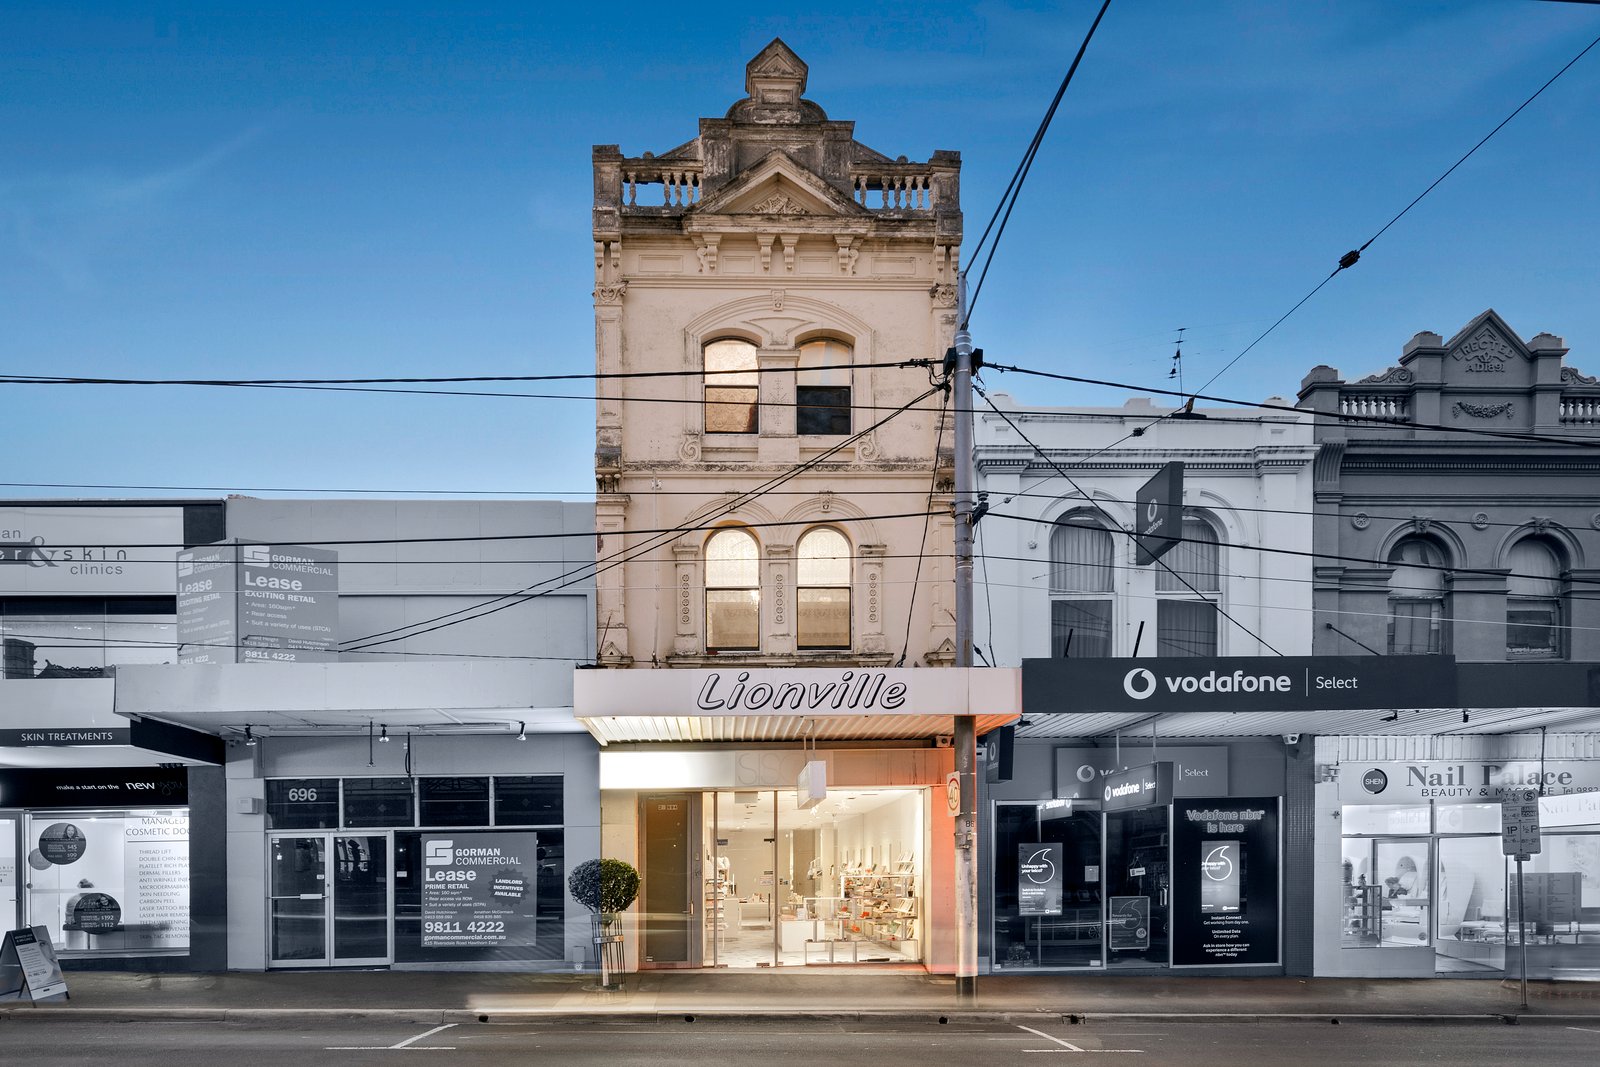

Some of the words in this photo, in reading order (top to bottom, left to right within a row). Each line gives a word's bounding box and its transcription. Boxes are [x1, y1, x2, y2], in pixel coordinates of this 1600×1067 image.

[1452, 340, 1515, 361] ERECTED
[63, 546, 127, 561] skin
[272, 554, 315, 566] GORMAN
[70, 563, 124, 575] clinics
[272, 562, 334, 576] COMMERCIAL
[245, 571, 303, 591] Lease
[179, 579, 213, 596] Lease
[245, 590, 285, 600] EXCITING
[287, 594, 317, 604] RETAIL
[244, 650, 270, 659] 9811
[271, 653, 296, 661] 4222
[1165, 670, 1291, 693] vodafone
[1316, 676, 1358, 689] Select
[697, 671, 907, 711] Lionville
[21, 733, 45, 741] SKIN
[48, 732, 113, 741] TREATMENTS
[1184, 768, 1209, 777] Select
[1405, 765, 1466, 787] Nail
[125, 782, 156, 790] new
[1365, 777, 1384, 786] SHEN
[288, 788, 317, 801] 696
[1112, 782, 1140, 797] vodafone
[1145, 780, 1156, 791] Select
[1421, 787, 1473, 797] BEAUTY
[1479, 787, 1489, 797] &
[141, 817, 186, 825] MANAGED
[1186, 809, 1238, 821] Vodafone
[125, 828, 170, 836] COSMETIC
[1206, 821, 1218, 833] is
[1218, 821, 1244, 833] here
[455, 847, 501, 857] GORMAN
[455, 856, 522, 866] COMMERCIAL
[425, 867, 477, 882] Lease
[424, 921, 463, 933] 9811
[466, 921, 505, 933] 4222
[423, 934, 506, 942] gormancommercial.com.au
